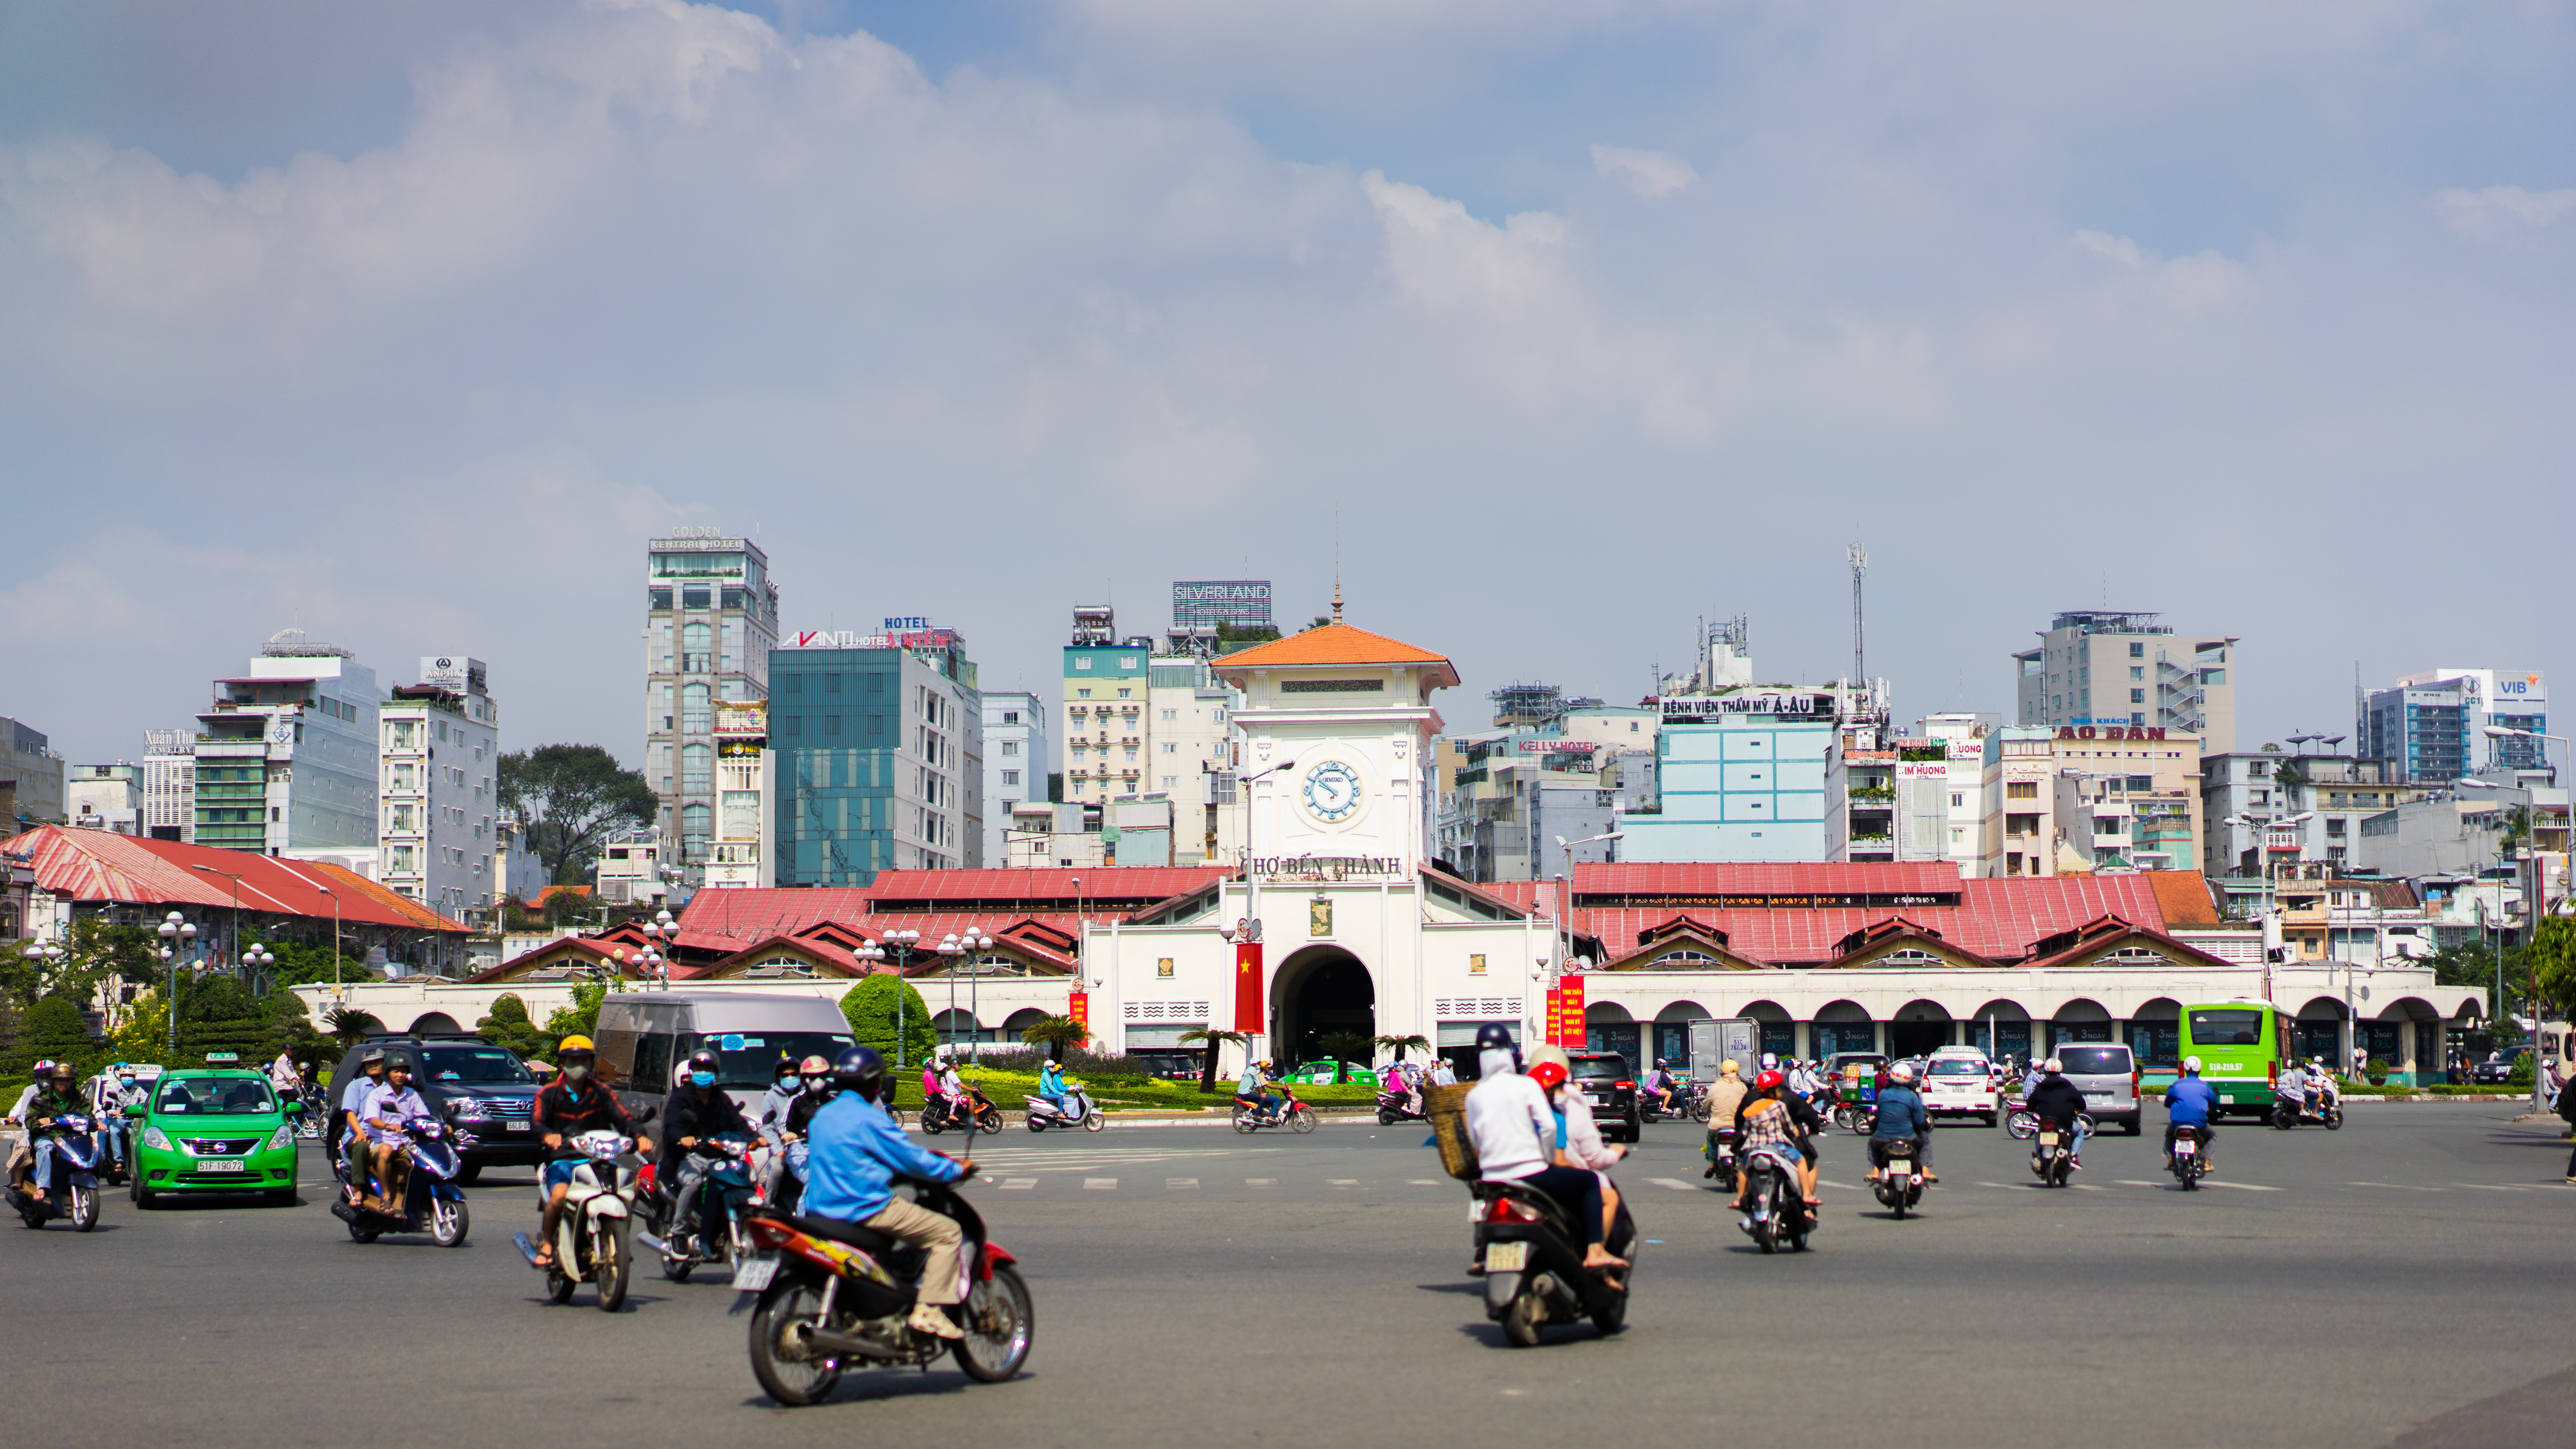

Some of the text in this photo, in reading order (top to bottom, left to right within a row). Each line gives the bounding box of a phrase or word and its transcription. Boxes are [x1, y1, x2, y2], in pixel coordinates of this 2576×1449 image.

[672, 526, 720, 538] GOLDEN
[653, 540, 741, 550] CENTRAL HOTEL
[1175, 586, 1268, 600] SILVERLAND
[885, 617, 930, 629] HOTEL
[782, 631, 890, 647] AVANTI HOTEL
[265, 642, 331, 654] Lavende Hotel
[2501, 681, 2526, 693] VIB
[1663, 699, 1692, 714] BỆNH
[1695, 699, 1717, 714] VIỆN
[1722, 697, 1750, 713] THẨM
[1753, 698, 1768, 712] MỸ
[145, 729, 195, 745] Xuân Thu
[1519, 741, 1597, 752] KELLY HOTEL
[1930, 738, 1948, 747] HOTEL
[1956, 745, 1981, 753] UONG
[1327, 761, 1338, 770] 12
[2009, 764, 2017, 773] A
[2030, 764, 2047, 773] EM
[1917, 766, 1946, 775] HUONG
[1303, 784, 1311, 796] 9
[1353, 786, 1361, 796] 3
[1328, 810, 1336, 819] 6
[1286, 852, 1322, 874] BẾN
[1331, 854, 1401, 874] THÀNH
[1611, 1031, 1617, 1040] 3
[1765, 1030, 1771, 1039] 3
[1845, 1030, 1851, 1039] 3
[2001, 1030, 2007, 1039] 3
[2081, 1030, 2087, 1039] 3
[2313, 1030, 2334, 1038] 3 NGÀY
[2374, 1029, 2379, 1037] 3
[2209, 1063, 2243, 1071] 51B-219.57
[199, 1161, 242, 1170] 51F-190.72
